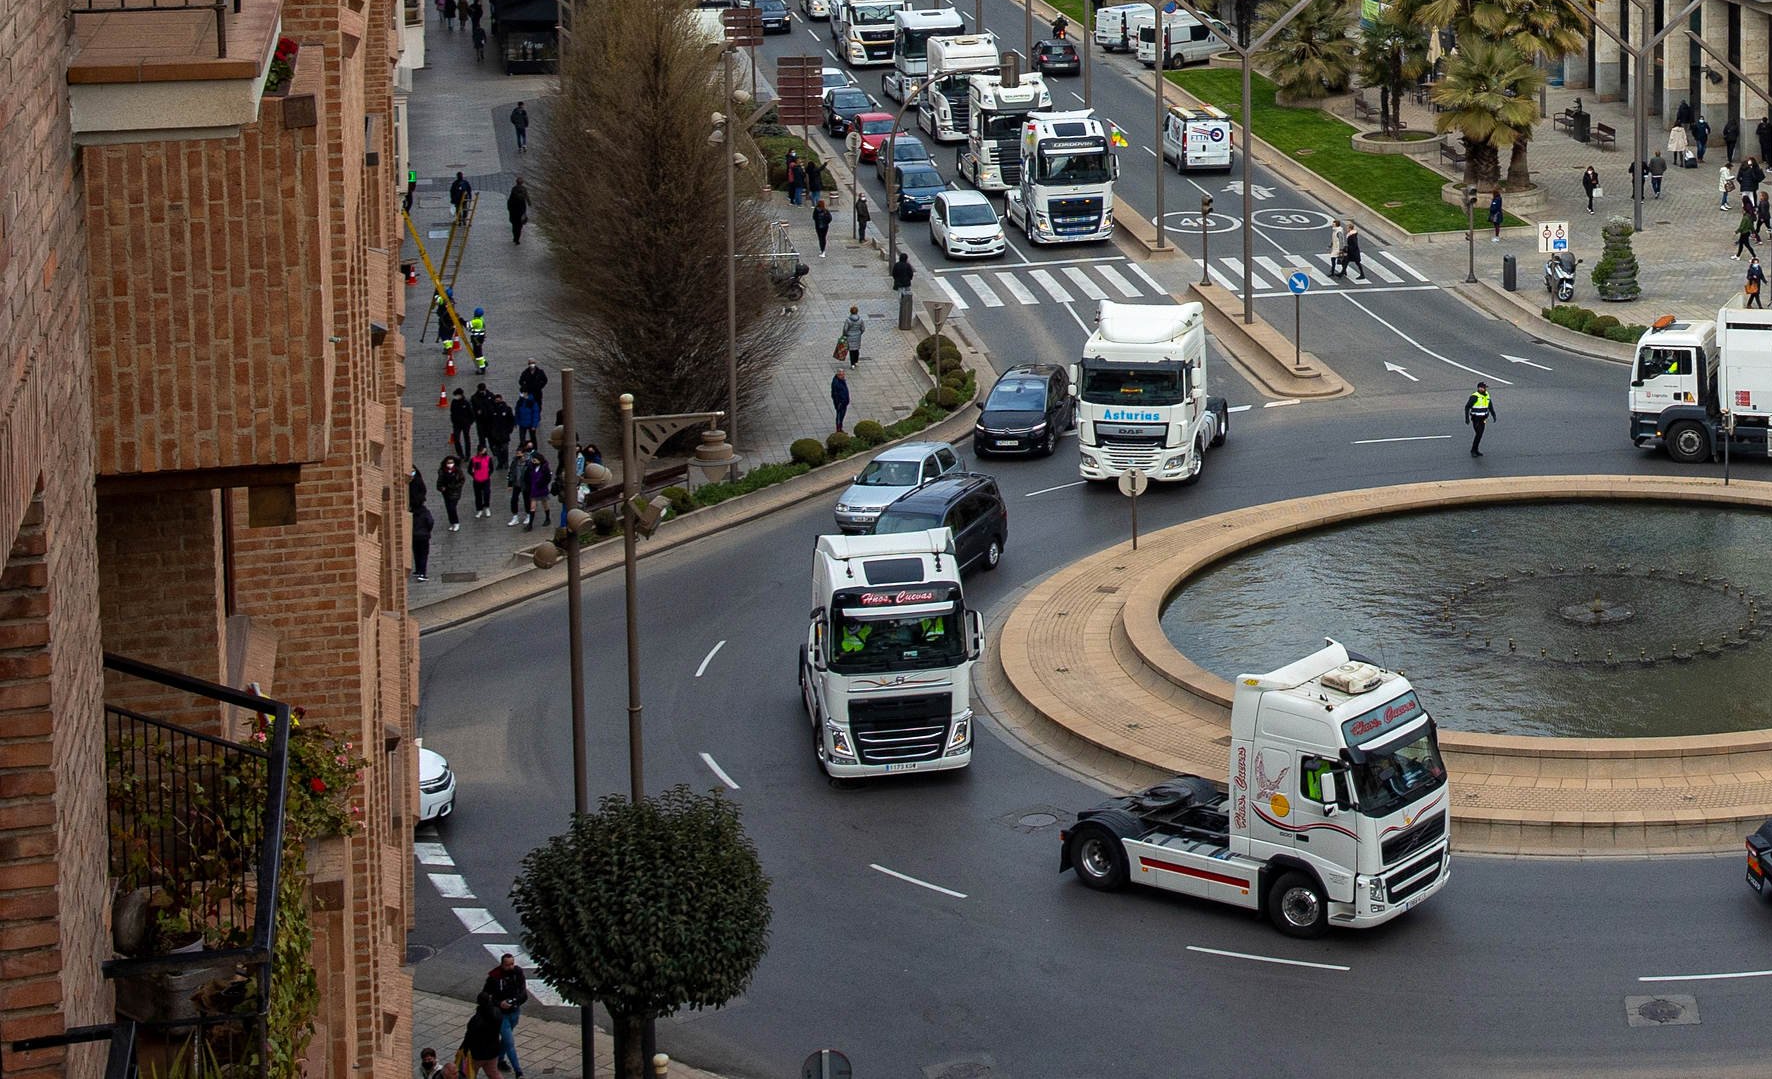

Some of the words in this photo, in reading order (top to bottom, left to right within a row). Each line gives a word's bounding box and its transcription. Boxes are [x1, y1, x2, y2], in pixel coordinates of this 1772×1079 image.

[1180, 217, 1216, 227] 40
[1271, 214, 1311, 224] 30
[1103, 408, 1160, 422] Asturias
[860, 593, 892, 605] Hnos.
[895, 590, 933, 604] Cuevas
[1384, 700, 1415, 723] Cuevas
[1235, 746, 1248, 791] Cuevas
[1233, 794, 1247, 830] Hnos.
